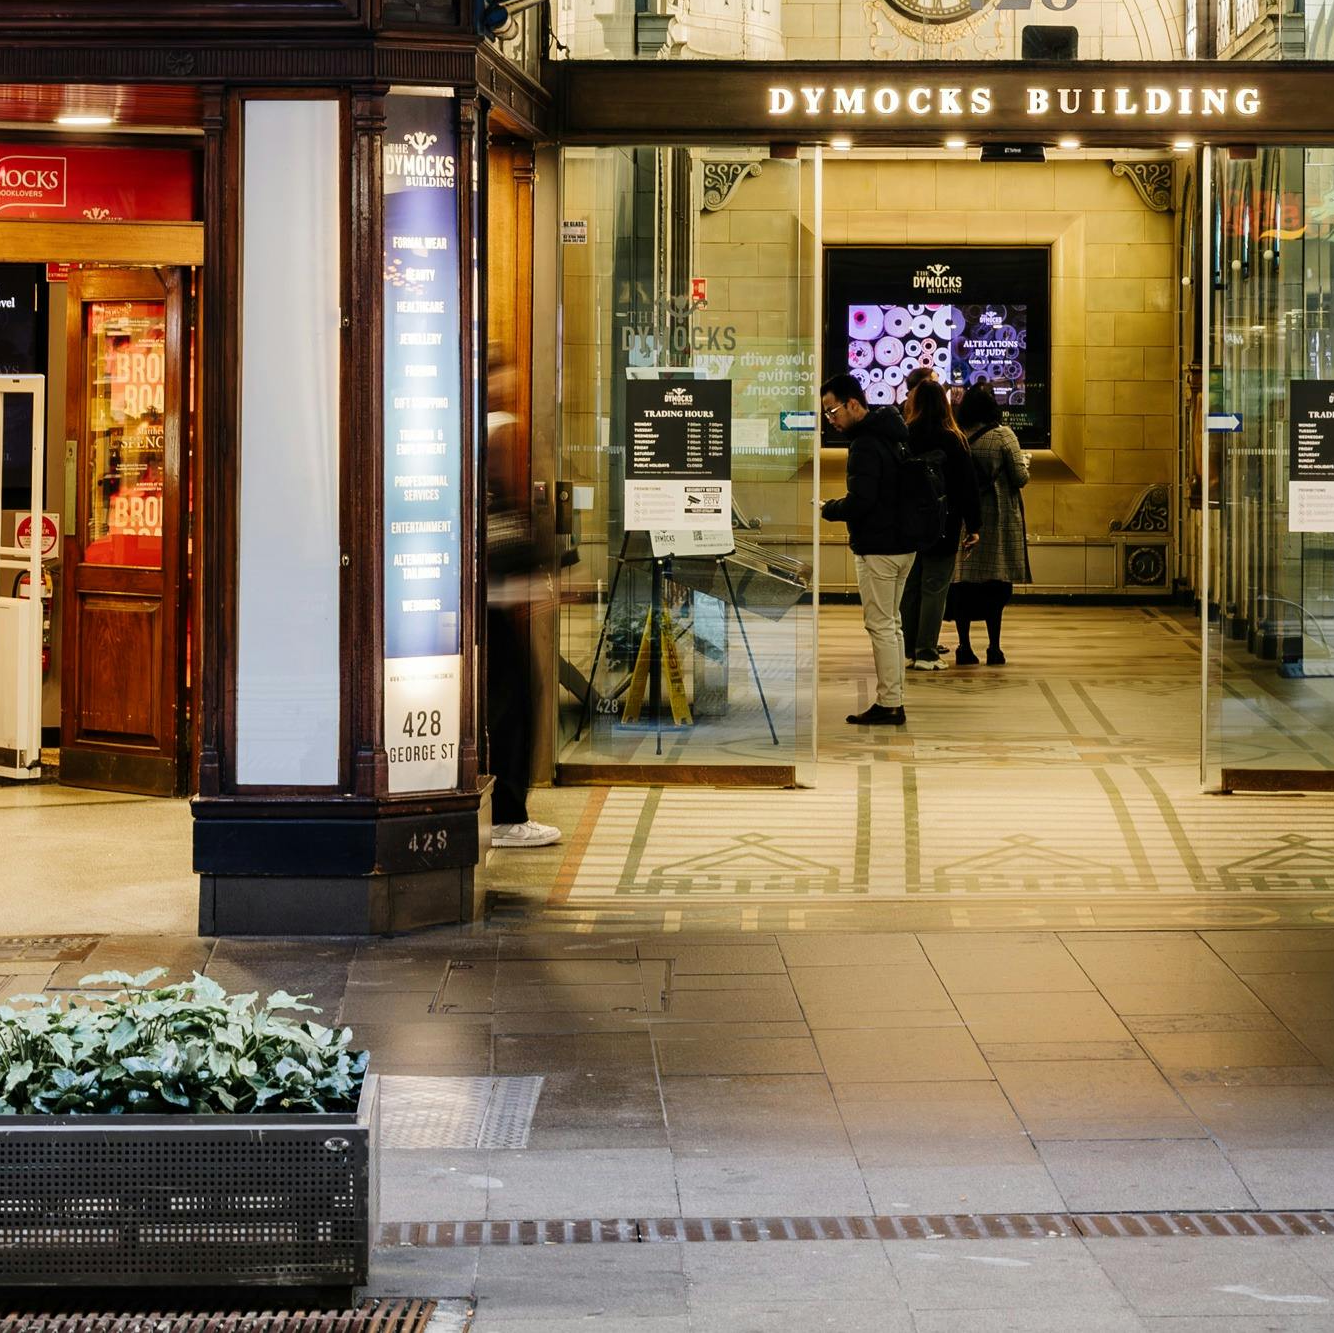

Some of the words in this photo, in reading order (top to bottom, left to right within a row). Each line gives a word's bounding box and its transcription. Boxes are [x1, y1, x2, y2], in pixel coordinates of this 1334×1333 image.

[768, 87, 993, 115] DYMOCKS
[1027, 87, 1262, 115] BUILDING
[389, 143, 409, 154] THE
[386, 156, 455, 177] DYMOCKS
[405, 177, 455, 188] BUILDING
[424, 237, 447, 249] WEAR
[913, 276, 962, 288] DYMOCKS
[964, 340, 1018, 348] ALTERATIONS
[985, 349, 1006, 357] JUDY
[394, 397, 410, 409] GIFT
[664, 394, 693, 403] DYMOCKS
[403, 489, 440, 502] SERVICES
[391, 520, 452, 534] ENTERTAINMENT
[596, 698, 618, 714] 428
[402, 710, 442, 738] 428
[389, 744, 436, 764] GEORGE
[441, 743, 455, 759] ST
[408, 830, 448, 852] 428
